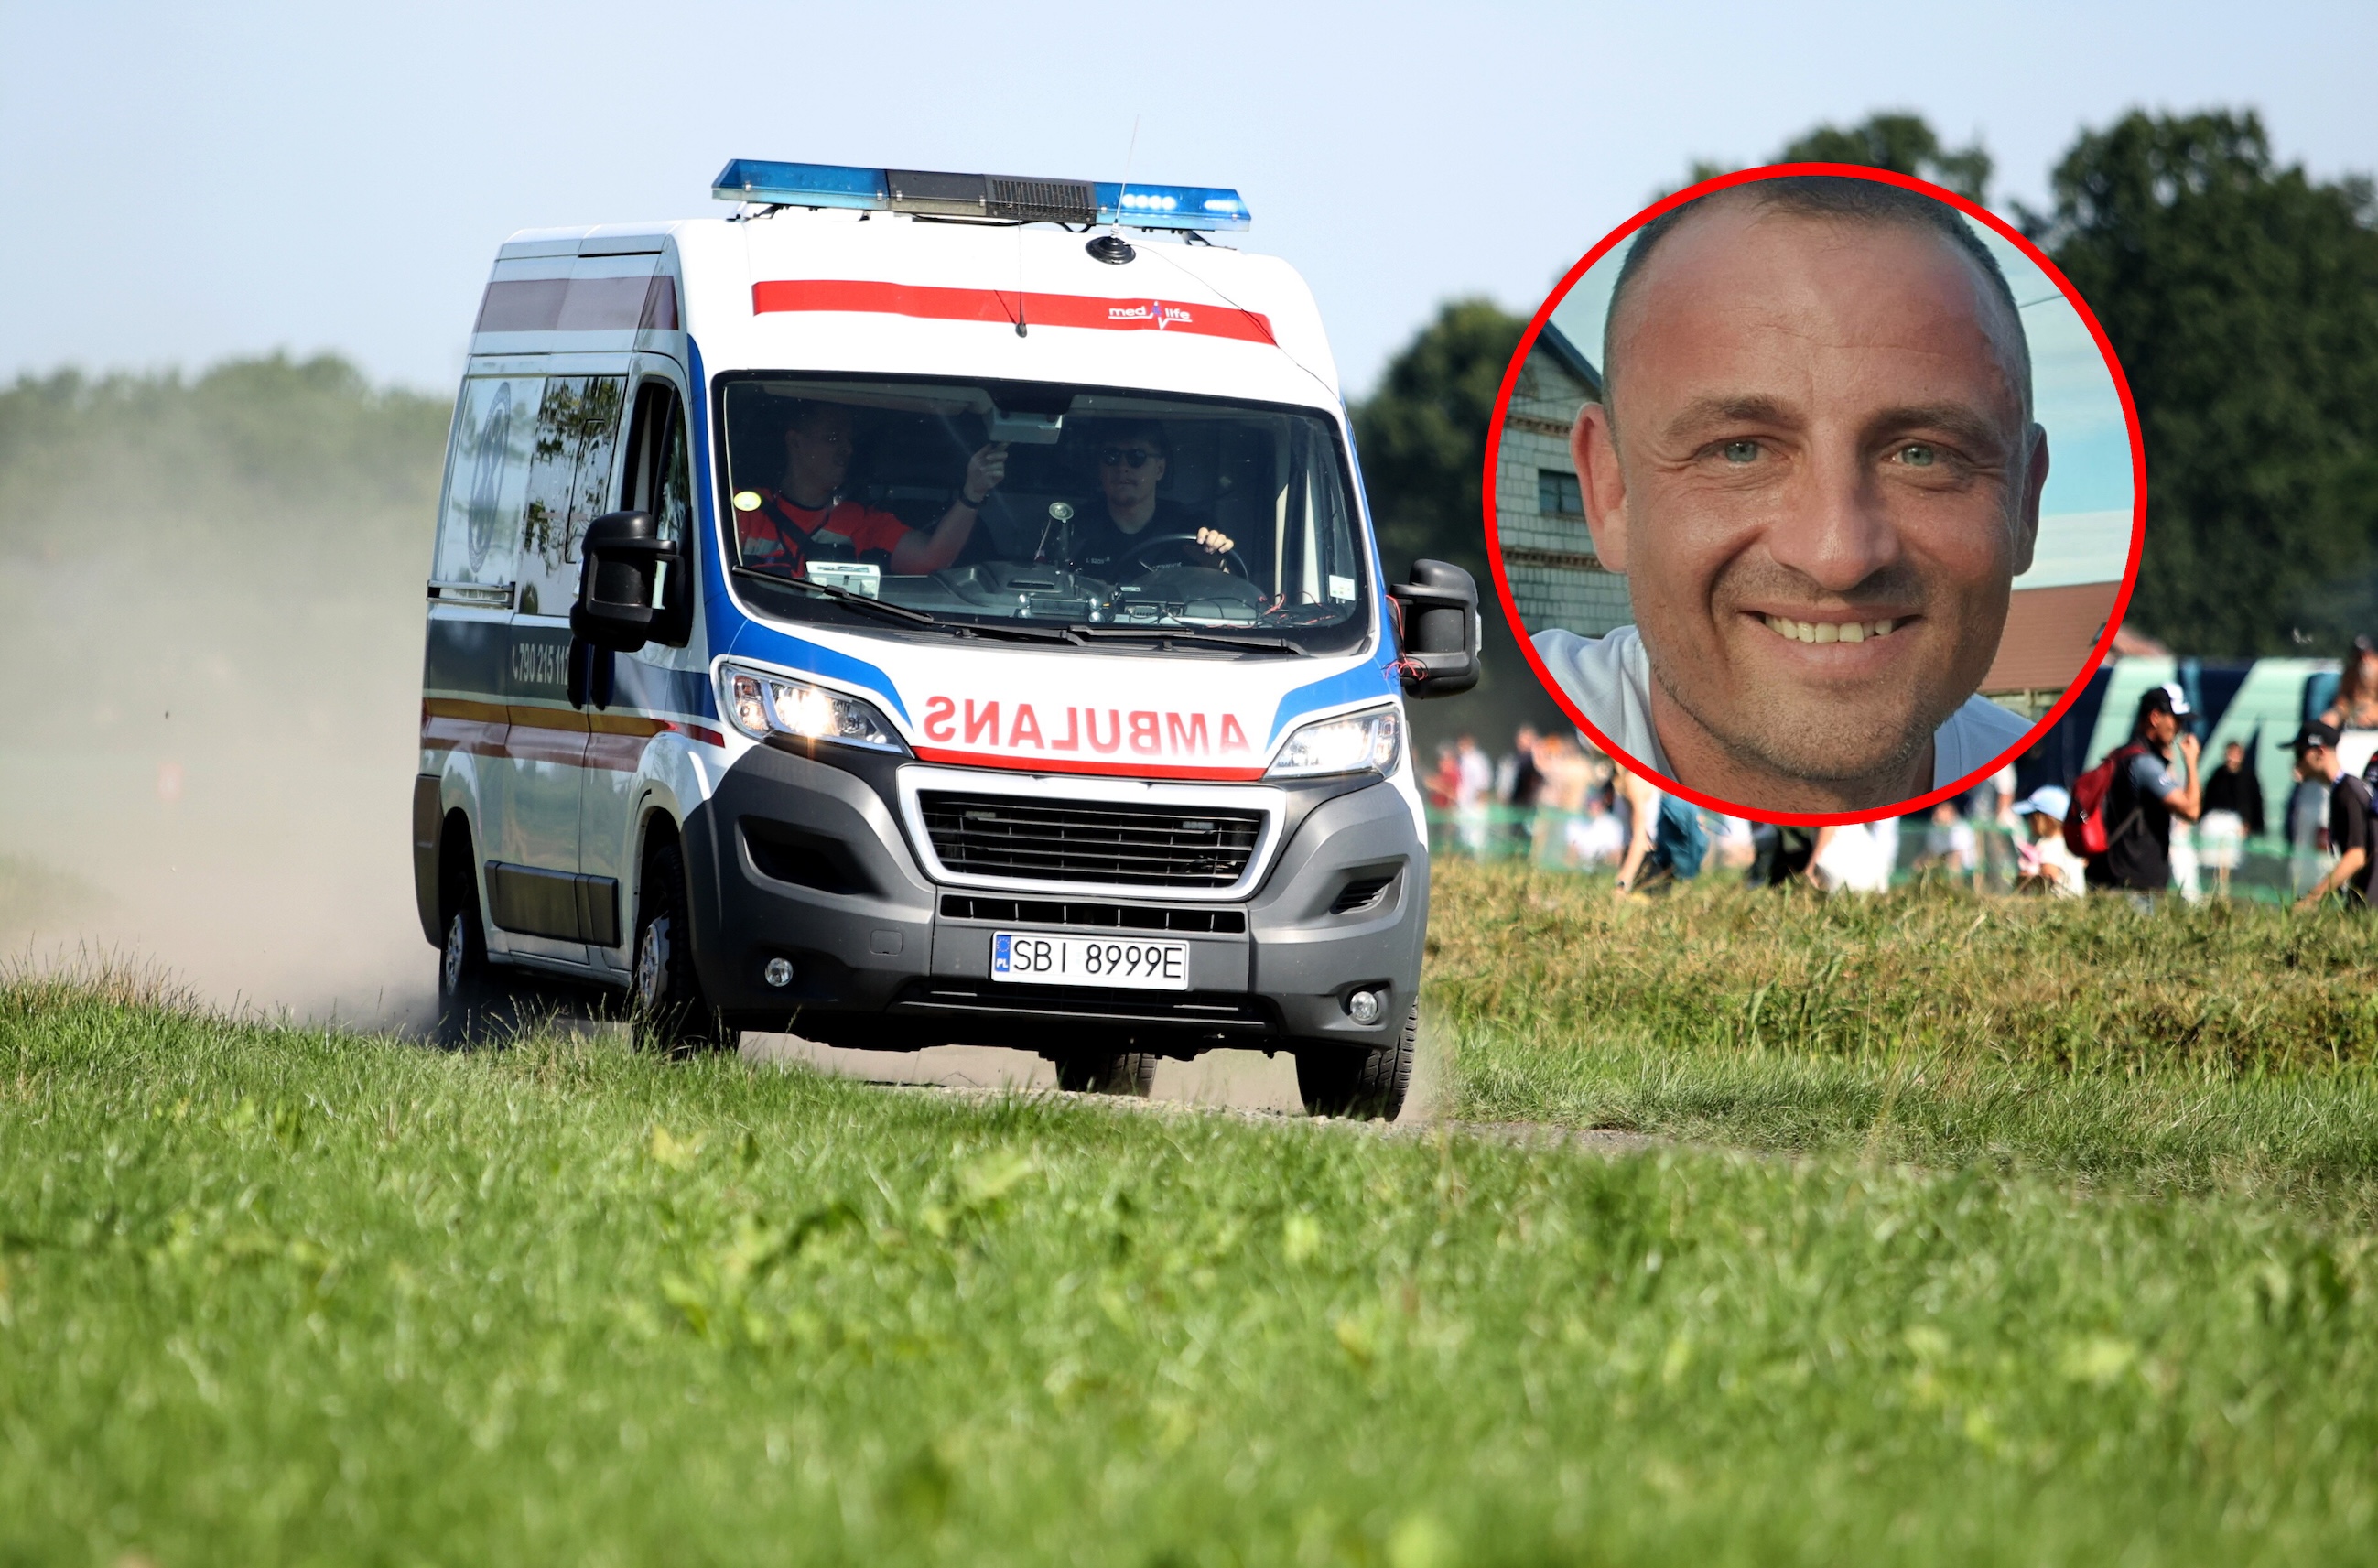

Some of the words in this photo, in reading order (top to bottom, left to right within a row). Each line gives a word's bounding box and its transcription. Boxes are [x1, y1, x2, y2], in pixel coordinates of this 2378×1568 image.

[1164, 307, 1191, 319] life
[518, 643, 535, 682] 790
[536, 643, 554, 684] 215
[996, 958, 1008, 968] PL
[1013, 939, 1066, 973] SBI
[1085, 943, 1183, 979] 8999E
